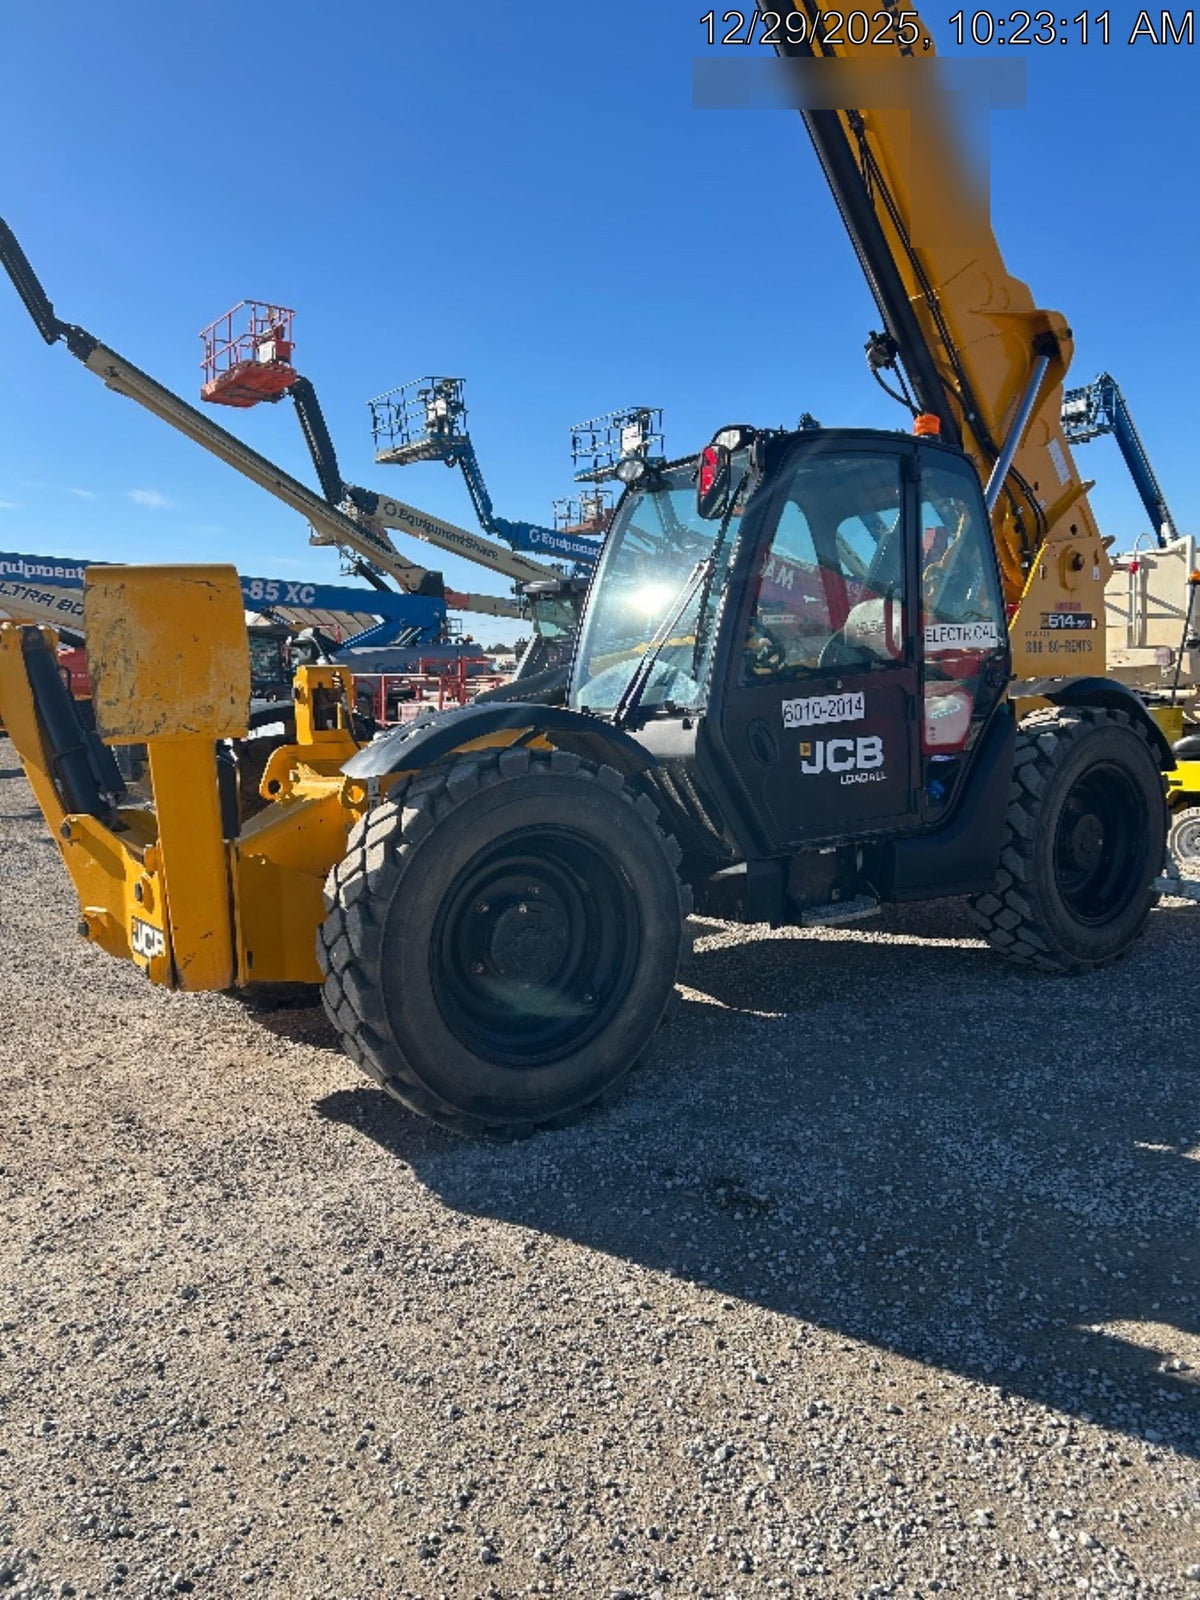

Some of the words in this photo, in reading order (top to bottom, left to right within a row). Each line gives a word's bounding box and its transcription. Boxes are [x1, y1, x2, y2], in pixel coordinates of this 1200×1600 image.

[284, 583, 316, 605] XC
[925, 625, 997, 642] ELECTRICAL
[783, 696, 863, 723] 6010-2014
[801, 736, 884, 774] JCB
